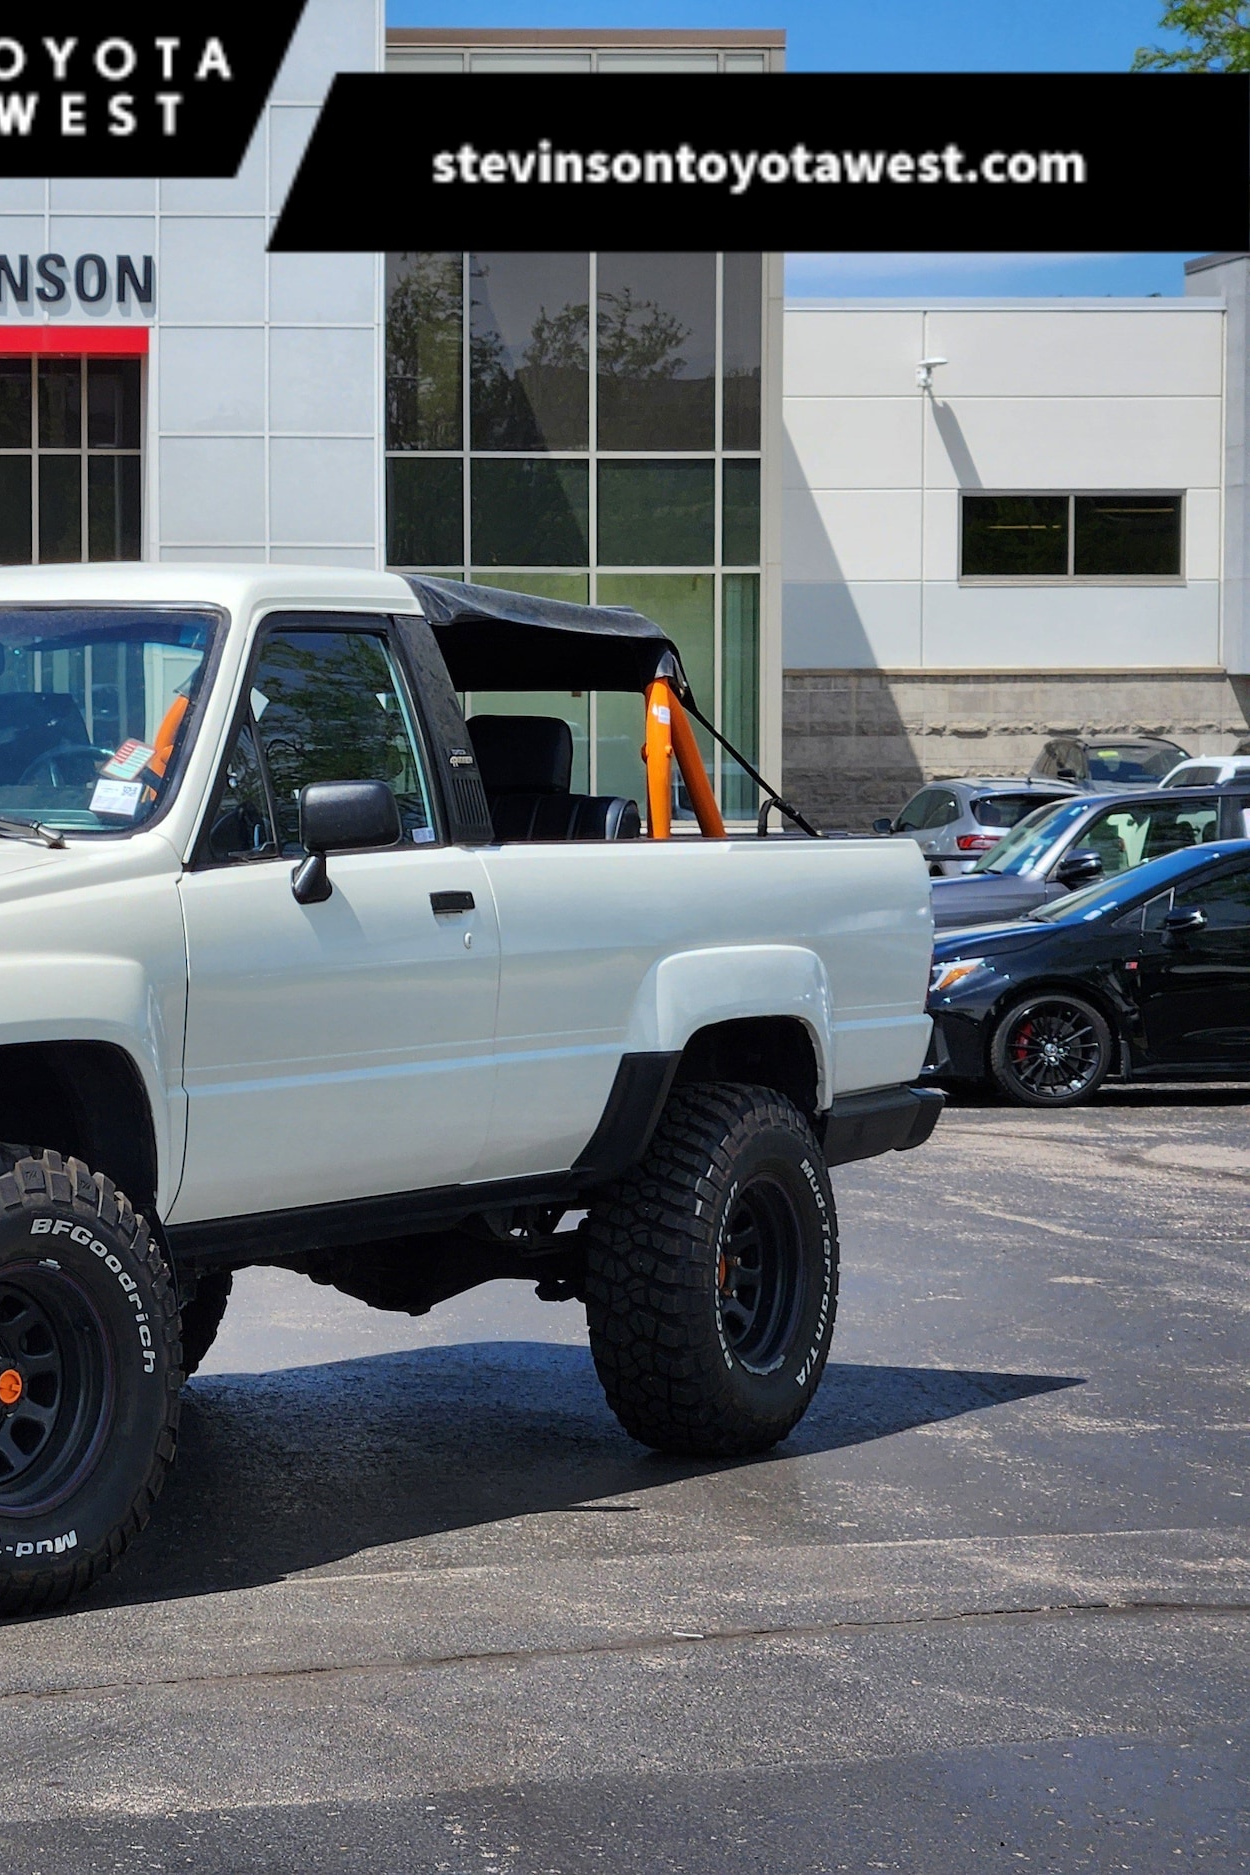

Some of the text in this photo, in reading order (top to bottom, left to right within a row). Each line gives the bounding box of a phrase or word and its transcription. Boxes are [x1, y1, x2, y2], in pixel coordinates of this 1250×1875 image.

[30, 1218, 156, 1373] BFGoodrich
[795, 1158, 832, 1387] Mud-Terrain T/A
